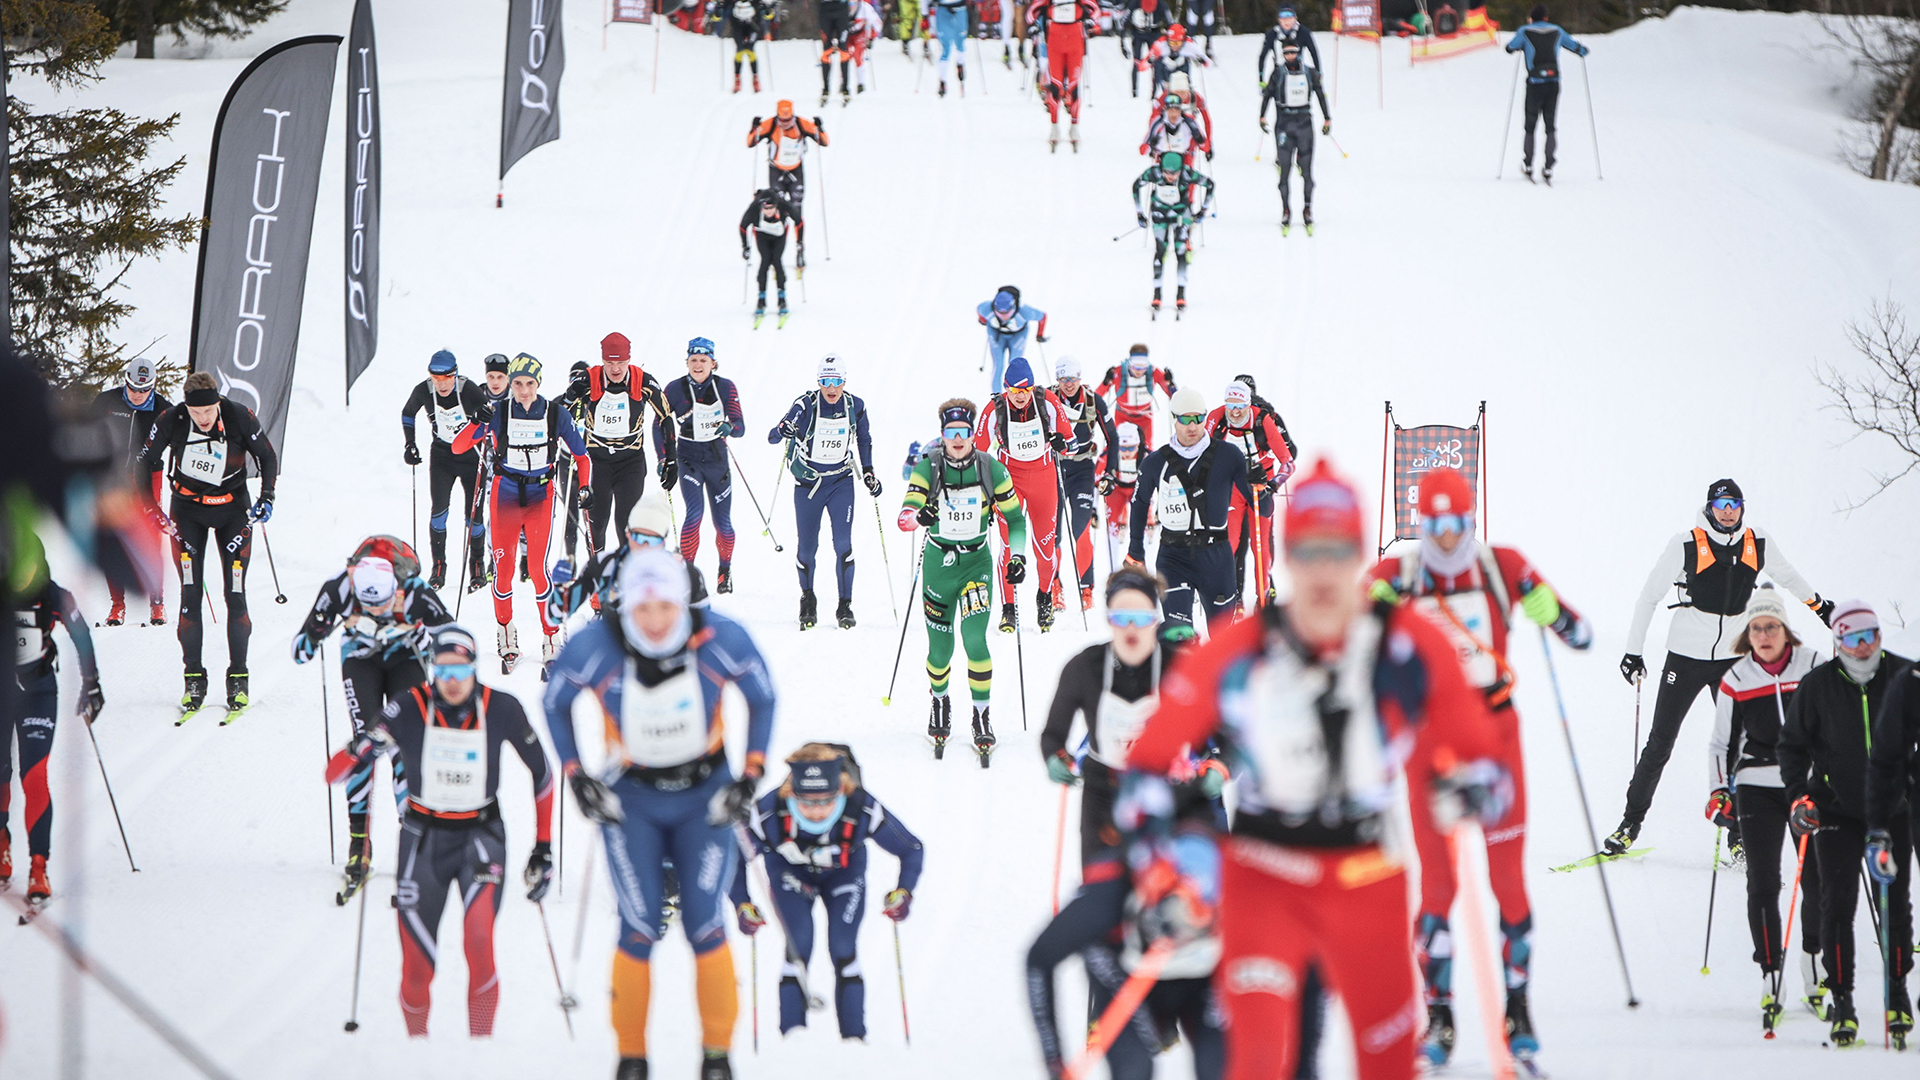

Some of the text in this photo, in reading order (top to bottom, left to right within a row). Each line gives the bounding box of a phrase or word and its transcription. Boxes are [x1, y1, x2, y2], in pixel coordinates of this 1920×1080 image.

[602, 414, 622, 424] 1851
[821, 440, 842, 448] 1756
[1017, 440, 1038, 450] 1663
[191, 458, 216, 474] 1681
[1165, 502, 1187, 514] 1561
[948, 511, 973, 521] 1813
[925, 615, 948, 632] WECO
